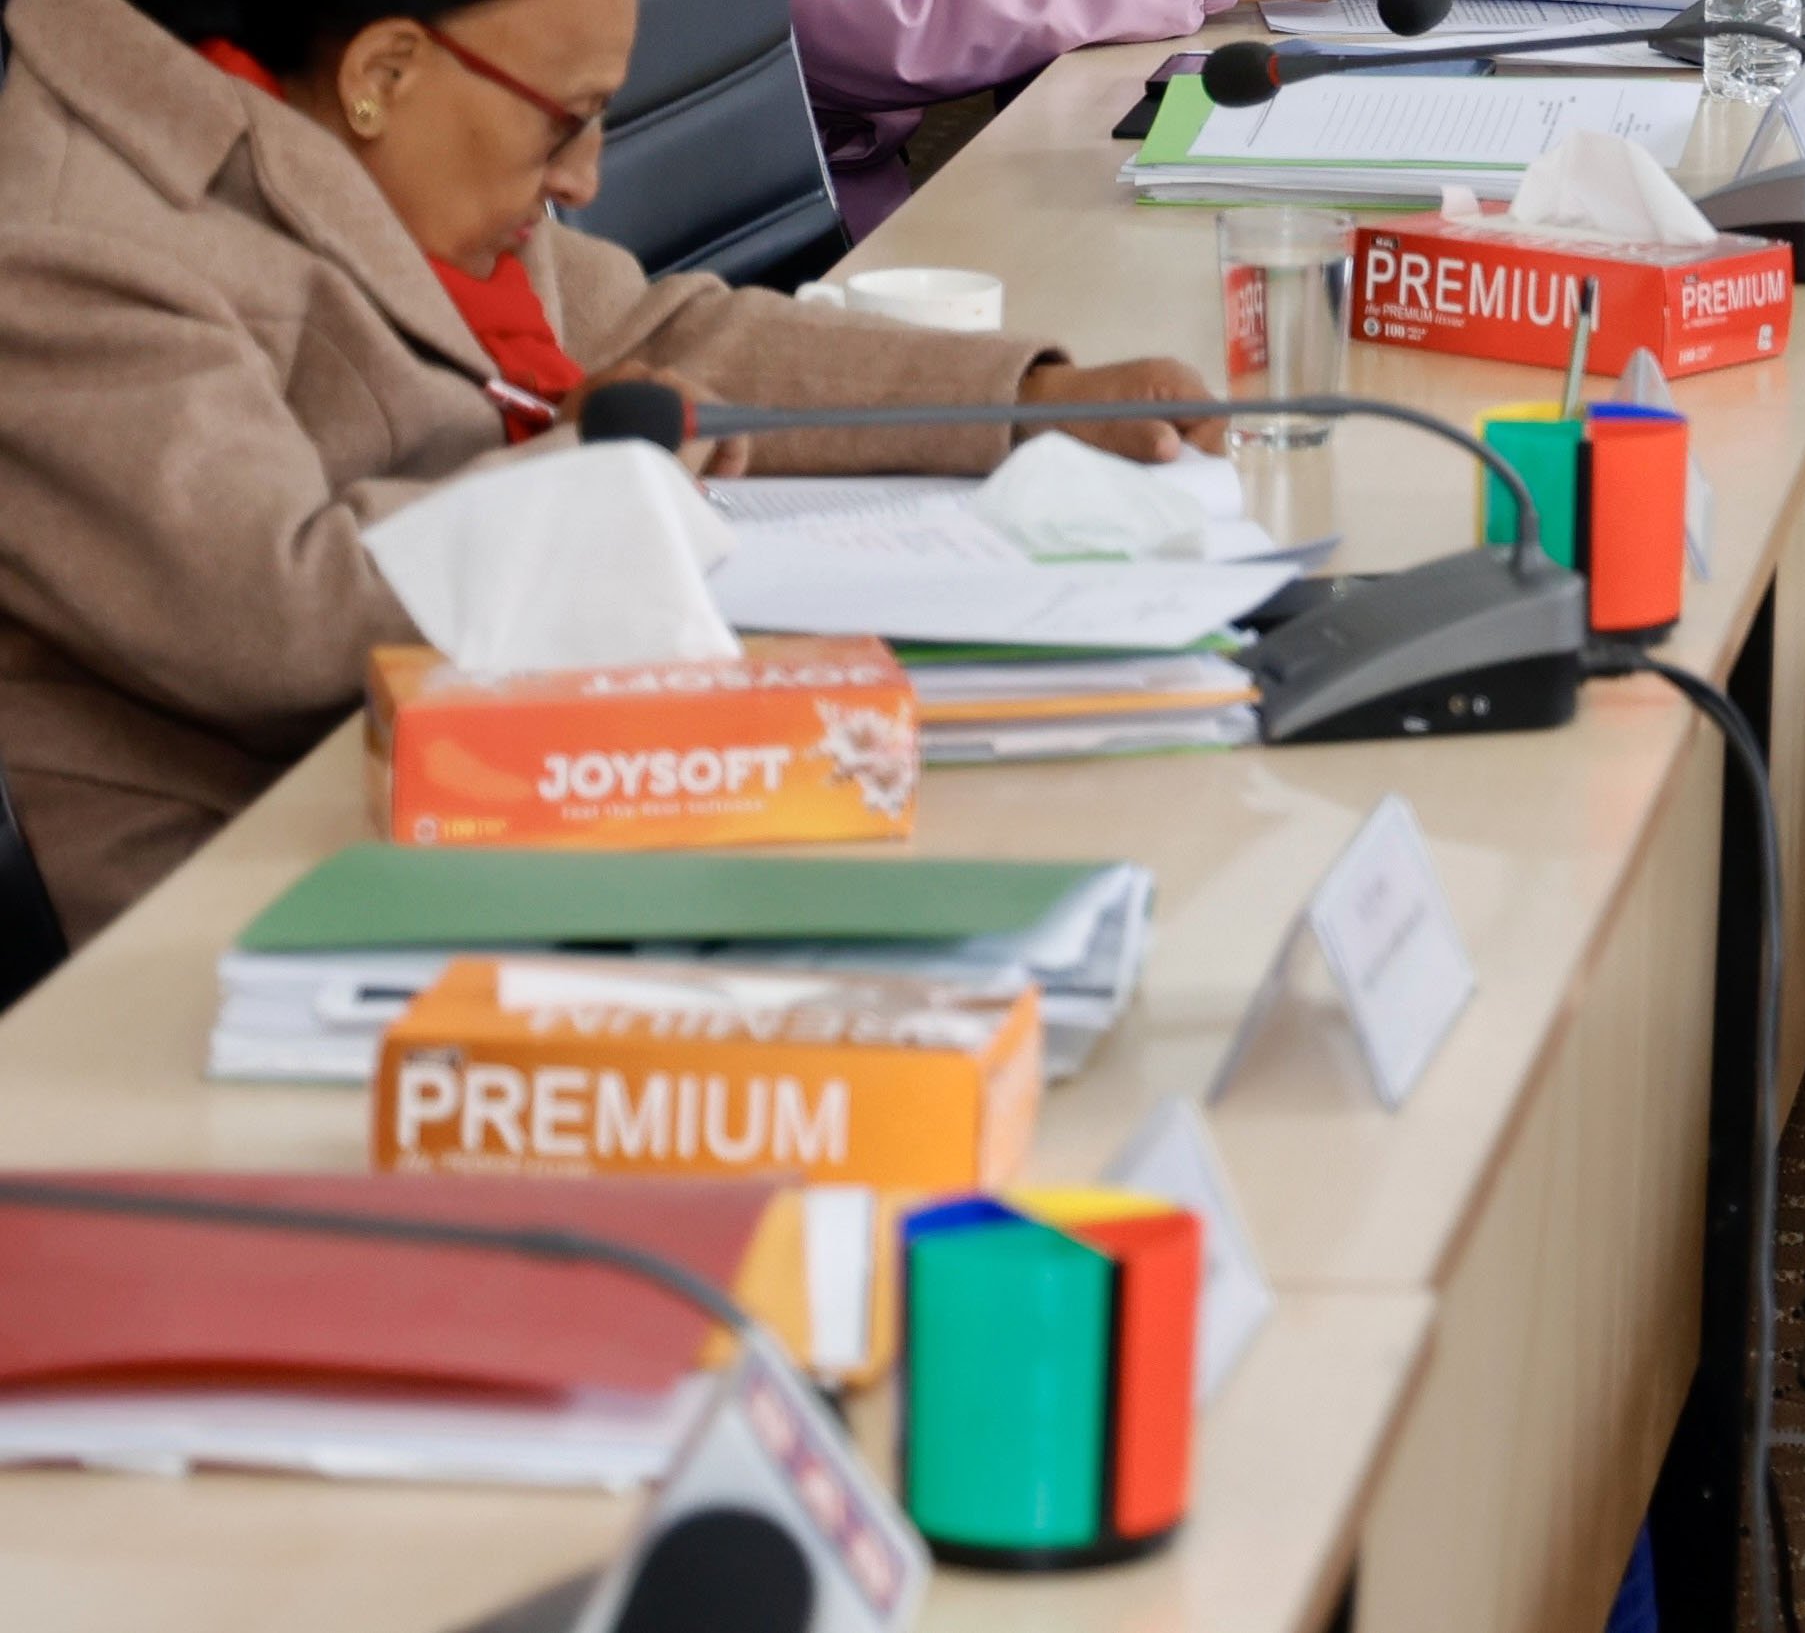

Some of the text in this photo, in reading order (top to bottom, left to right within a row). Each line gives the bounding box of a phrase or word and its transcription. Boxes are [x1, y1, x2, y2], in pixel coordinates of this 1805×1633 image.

[1366, 249, 1599, 332] PREMIUM
[1383, 303, 1433, 324] PREMIUM
[1682, 269, 1785, 320] PREMIUM
[539, 746, 789, 799] JOYSOFT
[395, 1065, 850, 1164] PREMIUM
